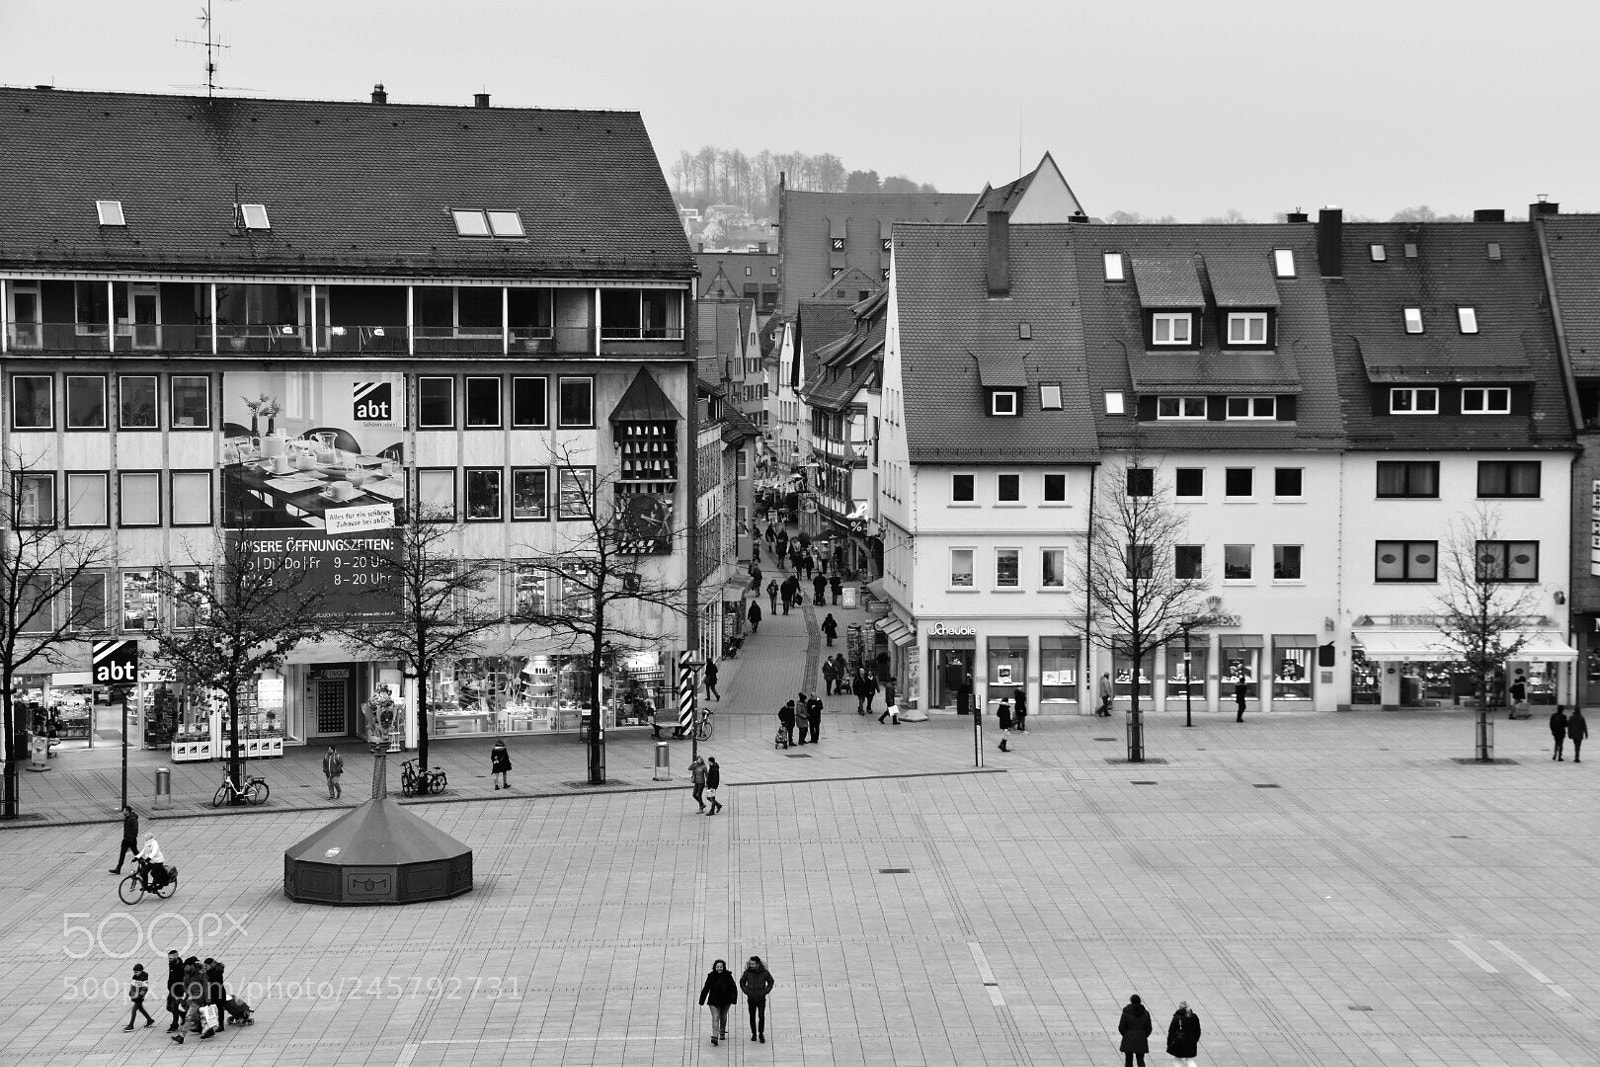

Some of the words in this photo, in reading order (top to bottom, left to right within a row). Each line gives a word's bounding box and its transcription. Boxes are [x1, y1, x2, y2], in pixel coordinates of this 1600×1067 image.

[357, 399, 389, 418] abt
[285, 537, 394, 552] ÖFFNUNGSZEITEN:
[284, 557, 301, 569] Do
[927, 621, 977, 636] Scheuble
[97, 660, 135, 682] abt
